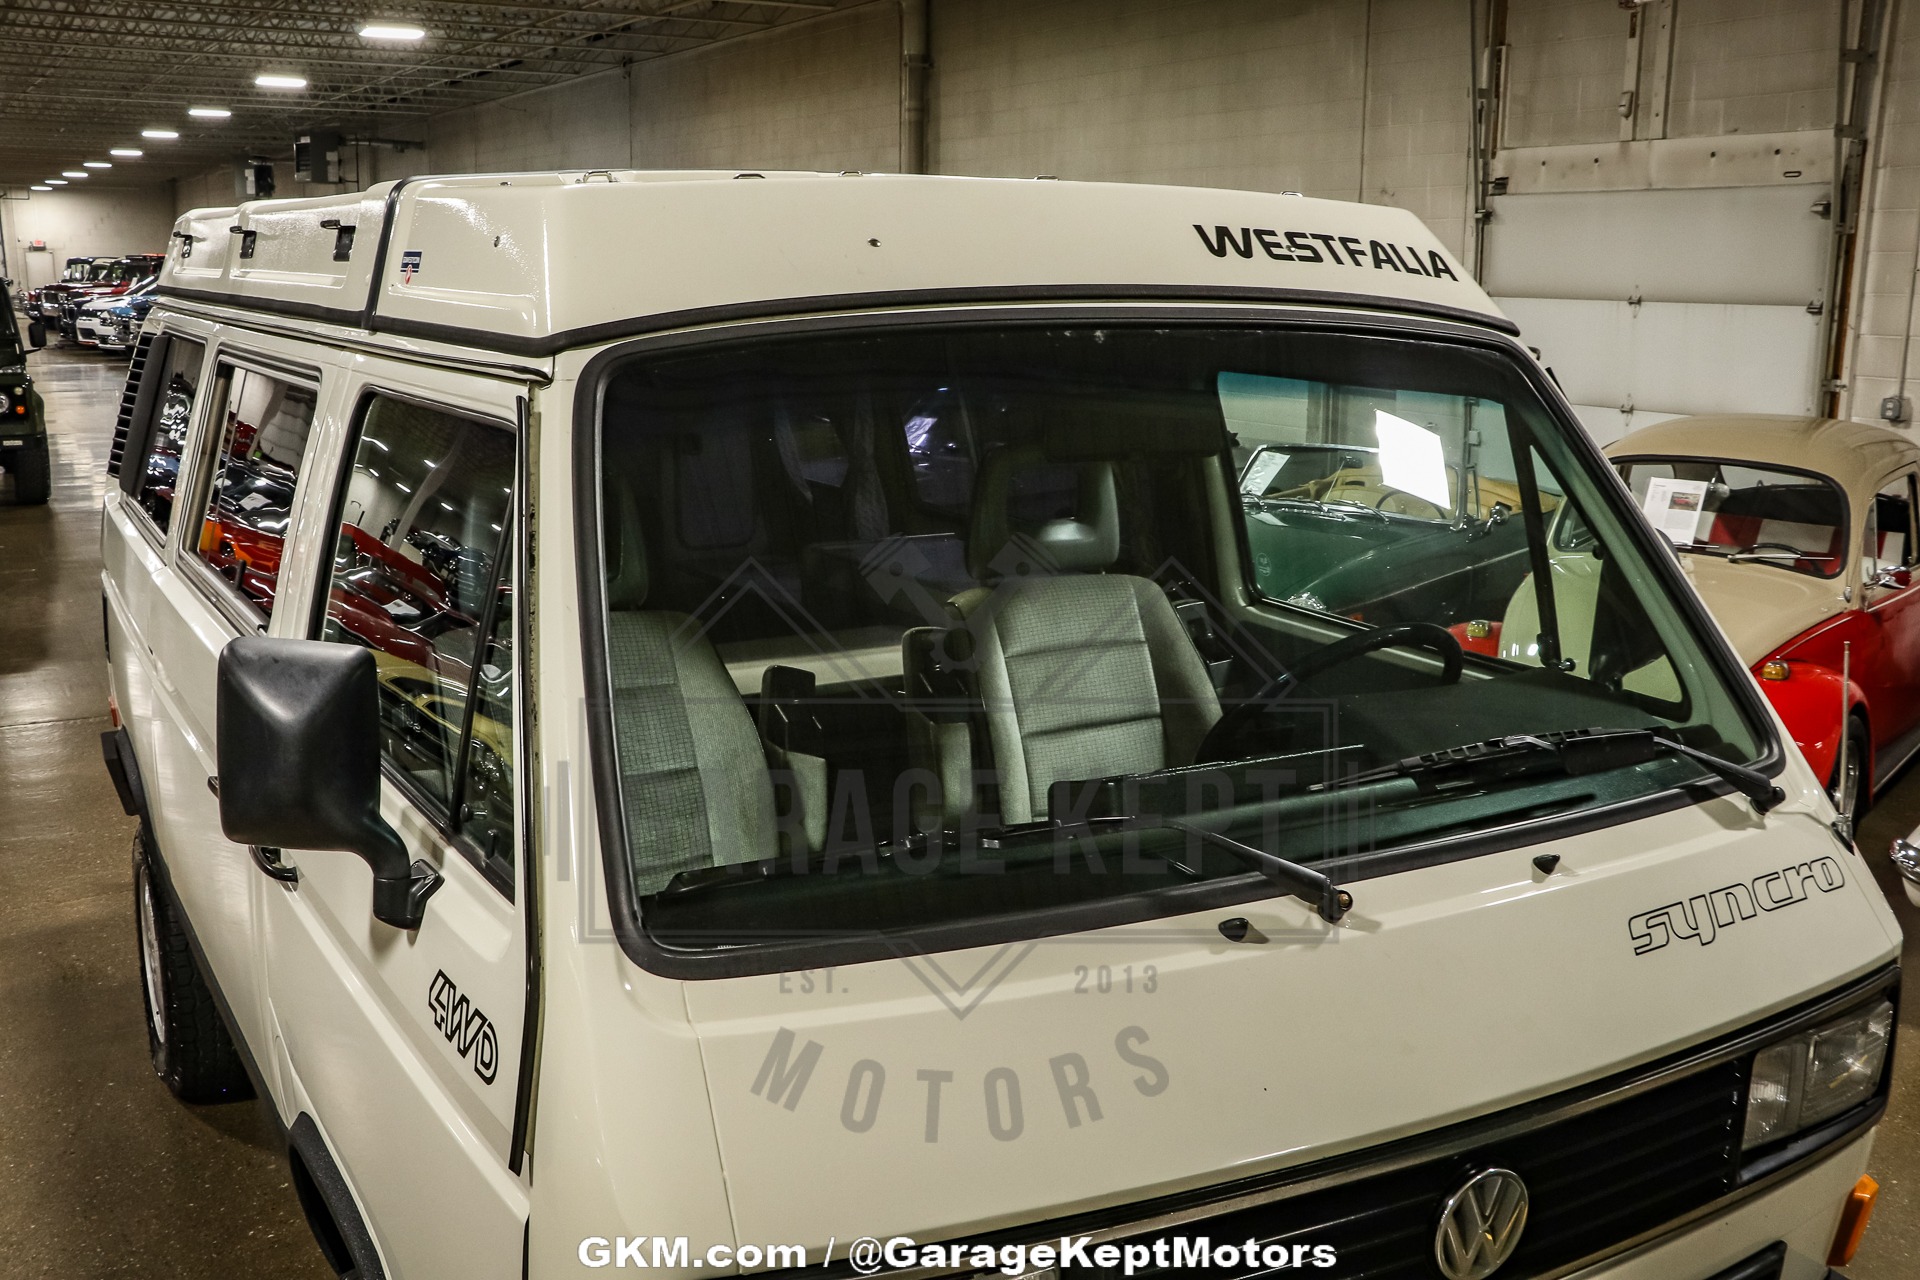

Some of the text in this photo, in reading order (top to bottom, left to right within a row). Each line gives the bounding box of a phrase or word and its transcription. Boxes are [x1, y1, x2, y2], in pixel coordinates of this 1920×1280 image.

[1192, 224, 1459, 282] WESTFALIA
[1628, 856, 1845, 956] syncro
[428, 968, 498, 1085] 4WD
